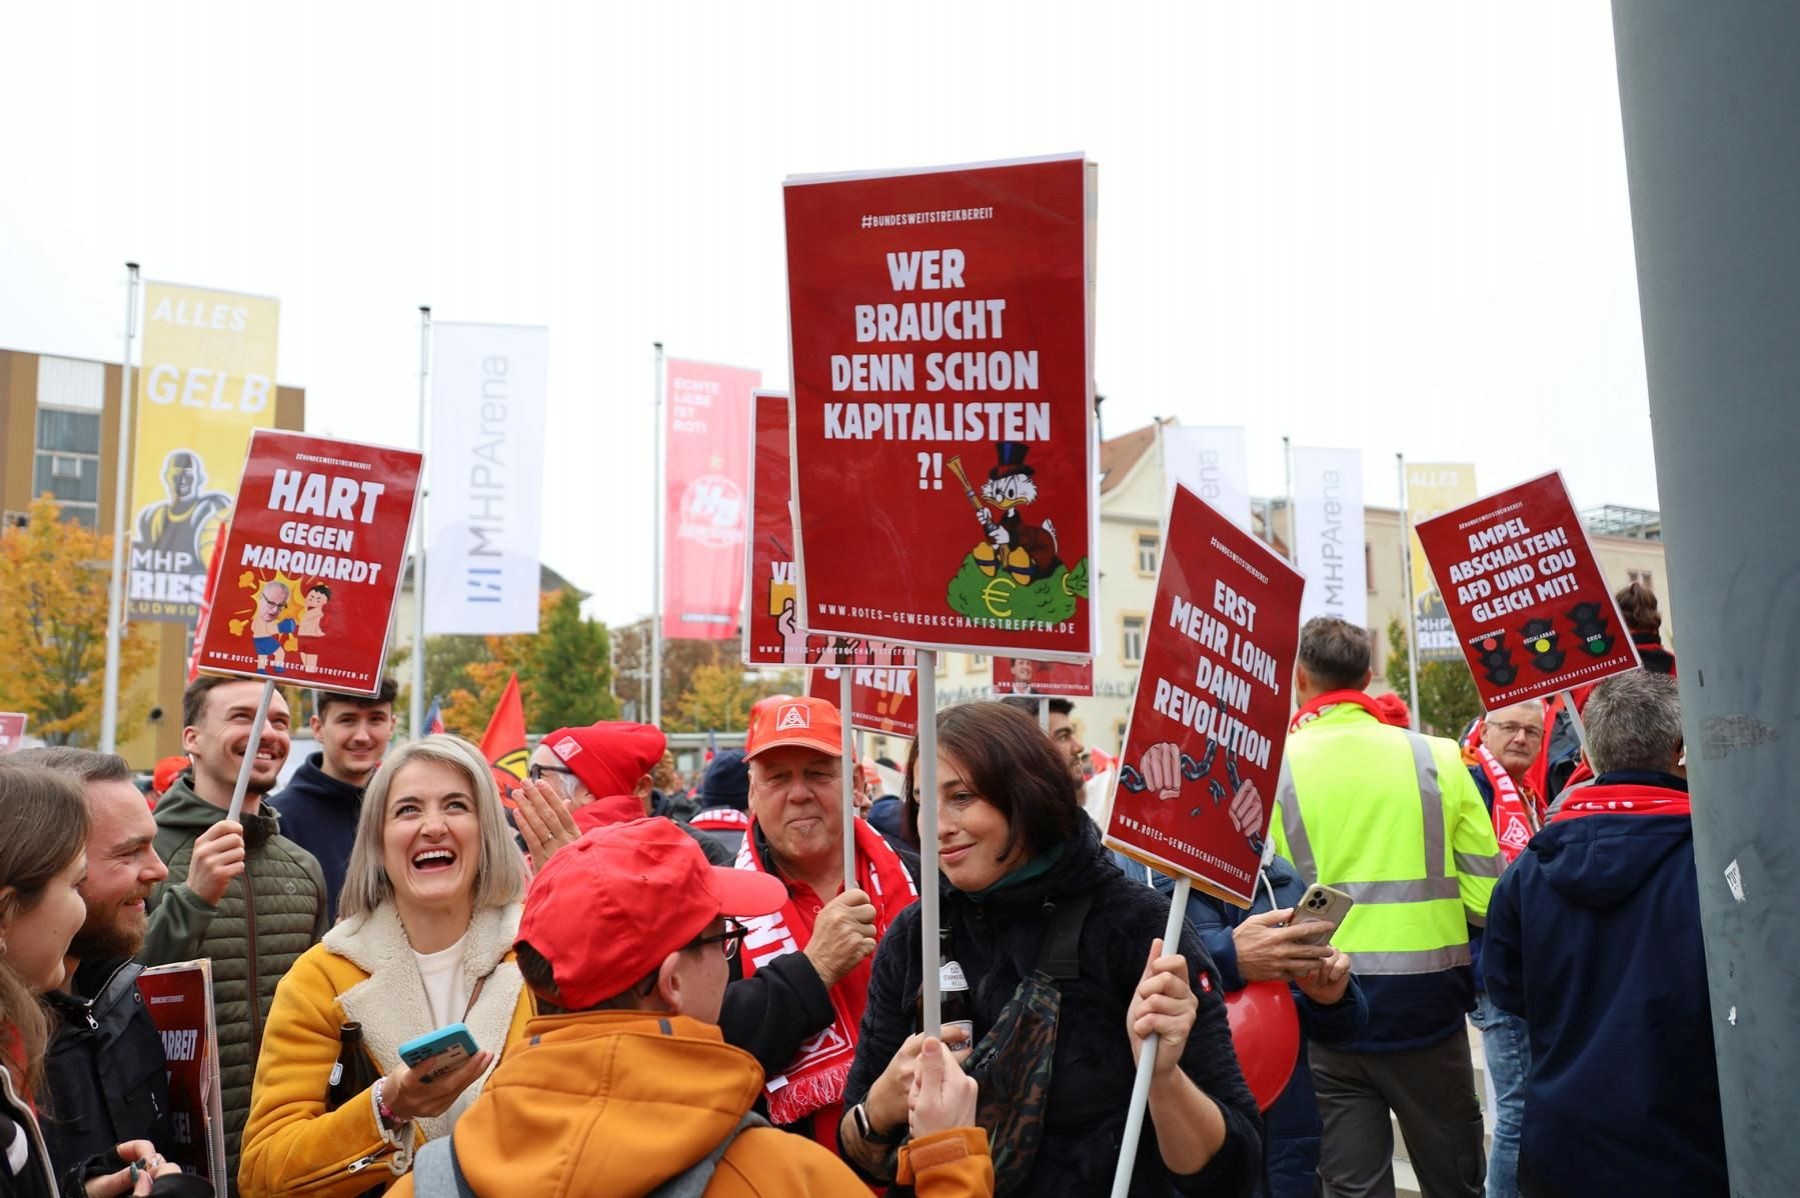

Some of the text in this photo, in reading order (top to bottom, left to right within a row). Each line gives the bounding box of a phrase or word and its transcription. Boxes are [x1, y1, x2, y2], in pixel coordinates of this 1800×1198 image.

[862, 207, 994, 228] #BUNDESWEITSTREIKBEREIT
[886, 249, 966, 291] WER
[152, 297, 249, 332] ALLES
[855, 299, 1006, 342] BRAUCHT
[146, 363, 270, 414] GELB
[831, 350, 1038, 391] DENN SCHON
[823, 402, 1050, 442] KAPITALISTEN
[468, 353, 509, 557] MHPArena
[917, 452, 943, 490] ?!
[267, 468, 385, 524] HART
[279, 521, 354, 552] GEGEN
[1322, 469, 1344, 606] MHPArena
[1449, 526, 1568, 584] ABSCHALTEN!
[1468, 517, 1530, 553] AMPEL
[132, 548, 193, 573] MHP
[240, 544, 382, 585] MARQUARDT
[1458, 548, 1576, 605] AFD UND CDU
[818, 603, 1076, 635] WWW.ROTES-GEWERKSCHAFTSTREFFEN.DE
[1213, 579, 1256, 633] ERST
[1472, 572, 1579, 623] GLEICH MIT!
[1169, 595, 1280, 696] MEHR LOHN,
[1586, 633, 1602, 643] KRIEG
[1195, 656, 1251, 714] DANN
[1153, 677, 1272, 770] REVOLUTION
[1118, 814, 1252, 884] WWW.ROTES-GEWERKSCHAFTSTREFFEN.DE
